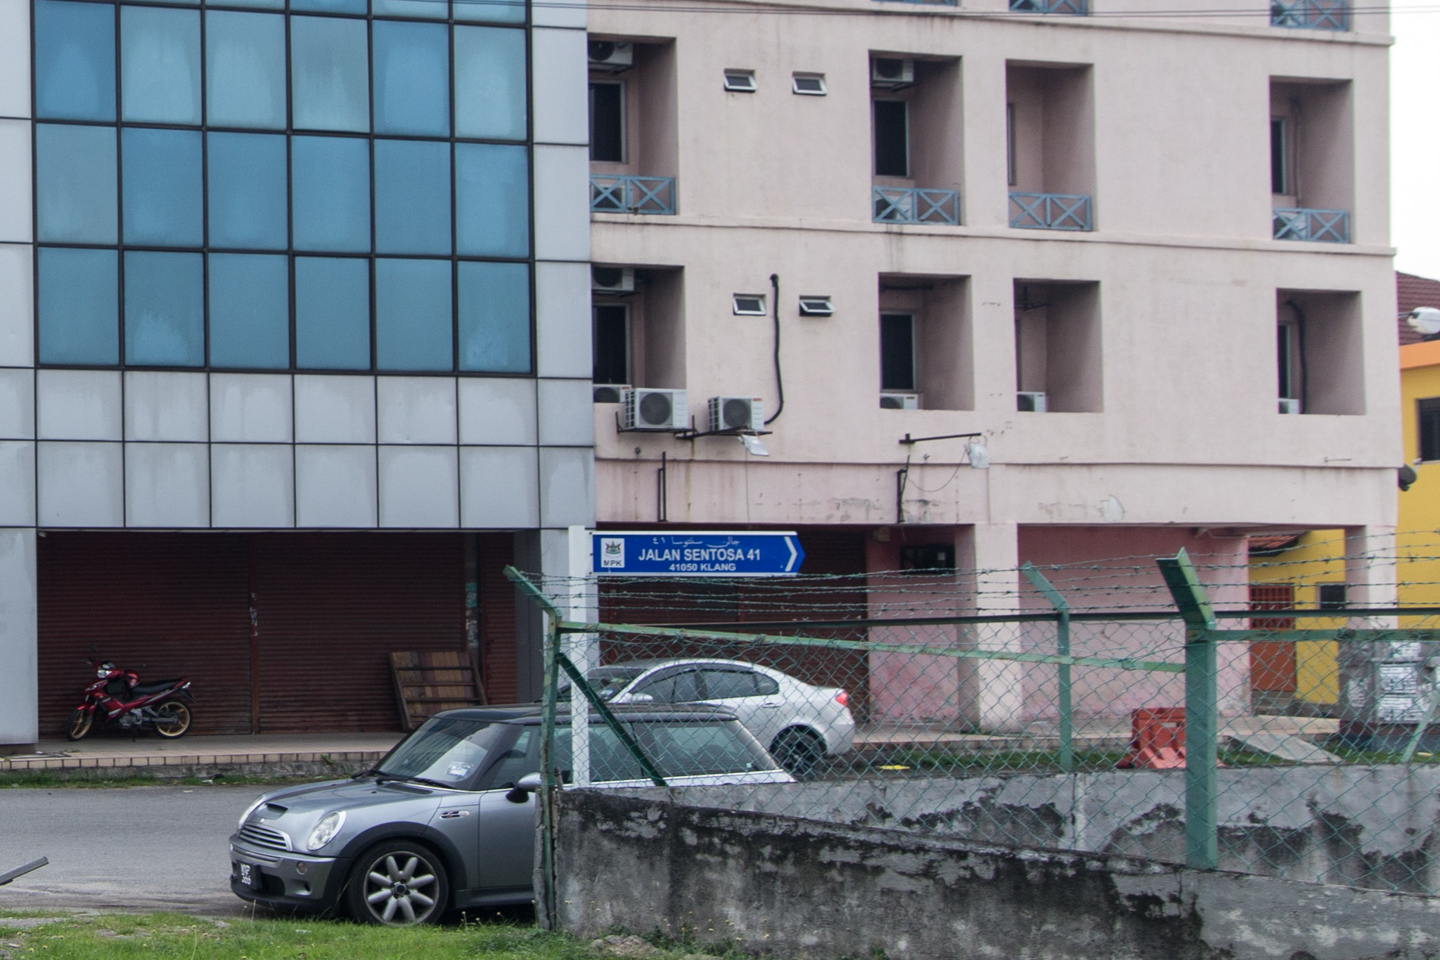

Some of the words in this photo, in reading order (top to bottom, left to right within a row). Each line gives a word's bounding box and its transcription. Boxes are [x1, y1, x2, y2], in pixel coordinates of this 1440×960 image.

[638, 548, 680, 561] JALAN
[684, 548, 745, 561] SENTOSA
[747, 548, 761, 561] 41
[669, 563, 698, 571] 41050
[700, 563, 736, 571] KLANG
